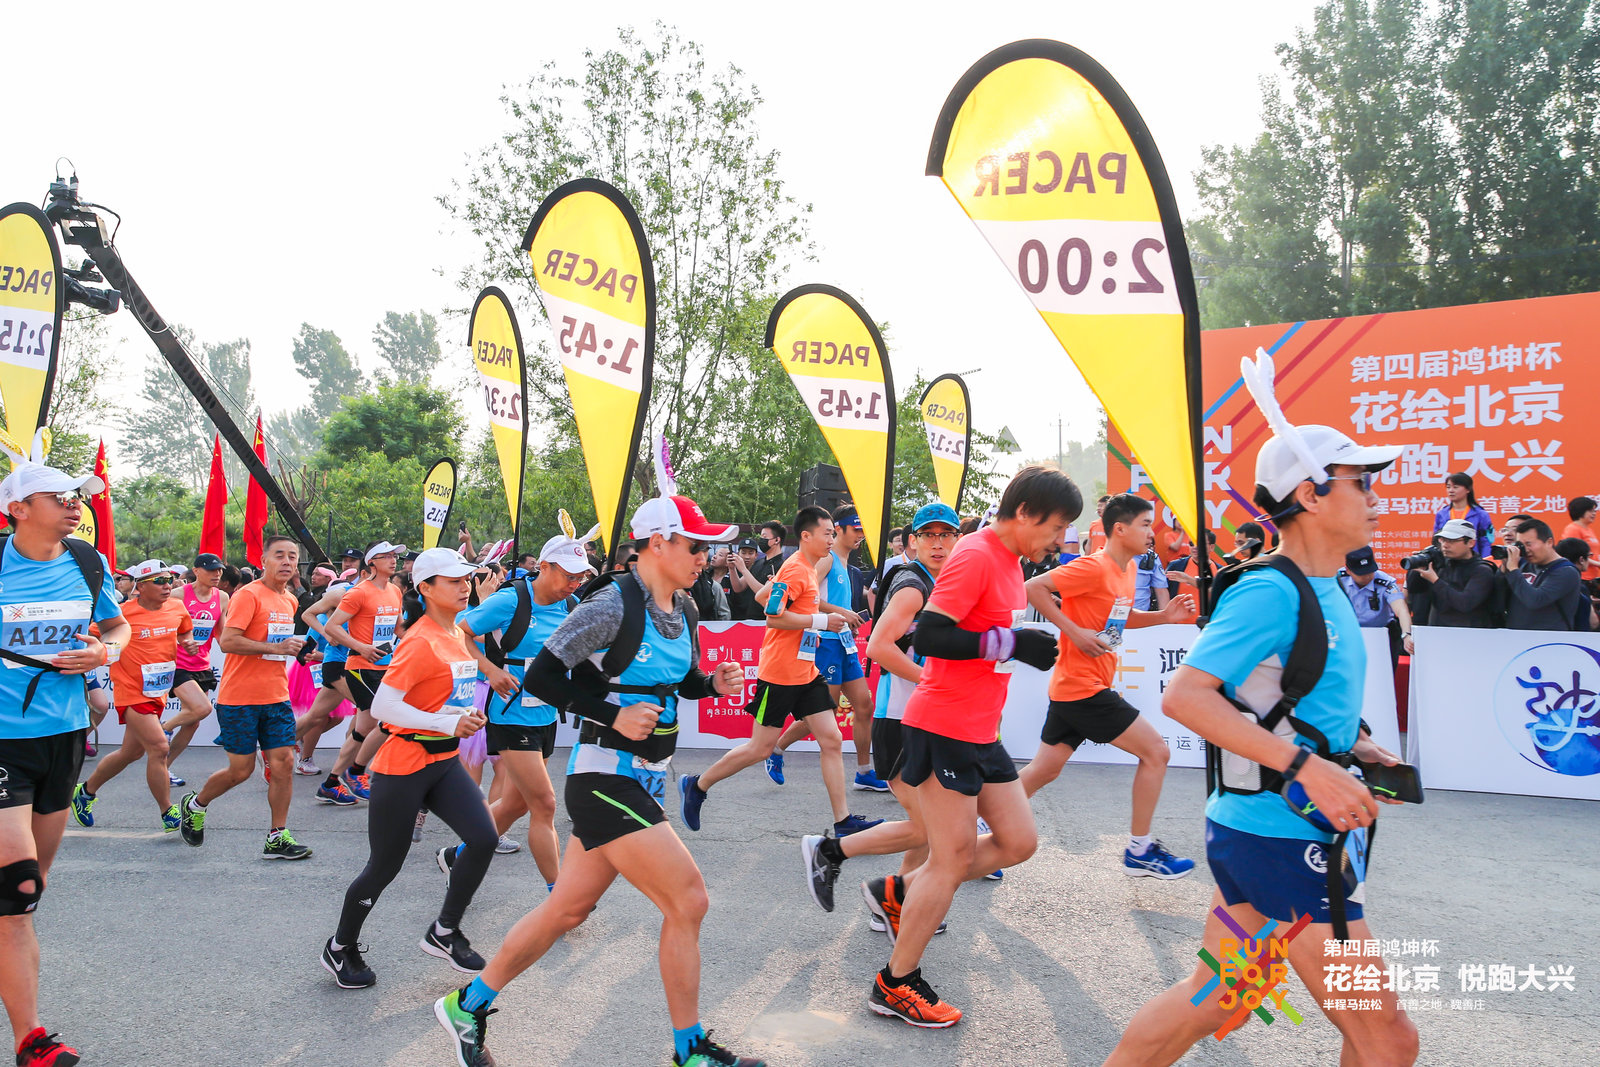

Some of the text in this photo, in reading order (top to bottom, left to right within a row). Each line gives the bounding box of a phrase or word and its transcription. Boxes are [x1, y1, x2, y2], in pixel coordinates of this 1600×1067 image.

[1350, 342, 1562, 384] 第四届鸿坤杯
[1349, 381, 1564, 434] 花绘北京
[1477, 495, 1567, 515] 首善之地
[8, 623, 83, 647] A1224
[193, 629, 209, 637] 065
[707, 648, 762, 662] 看儿童
